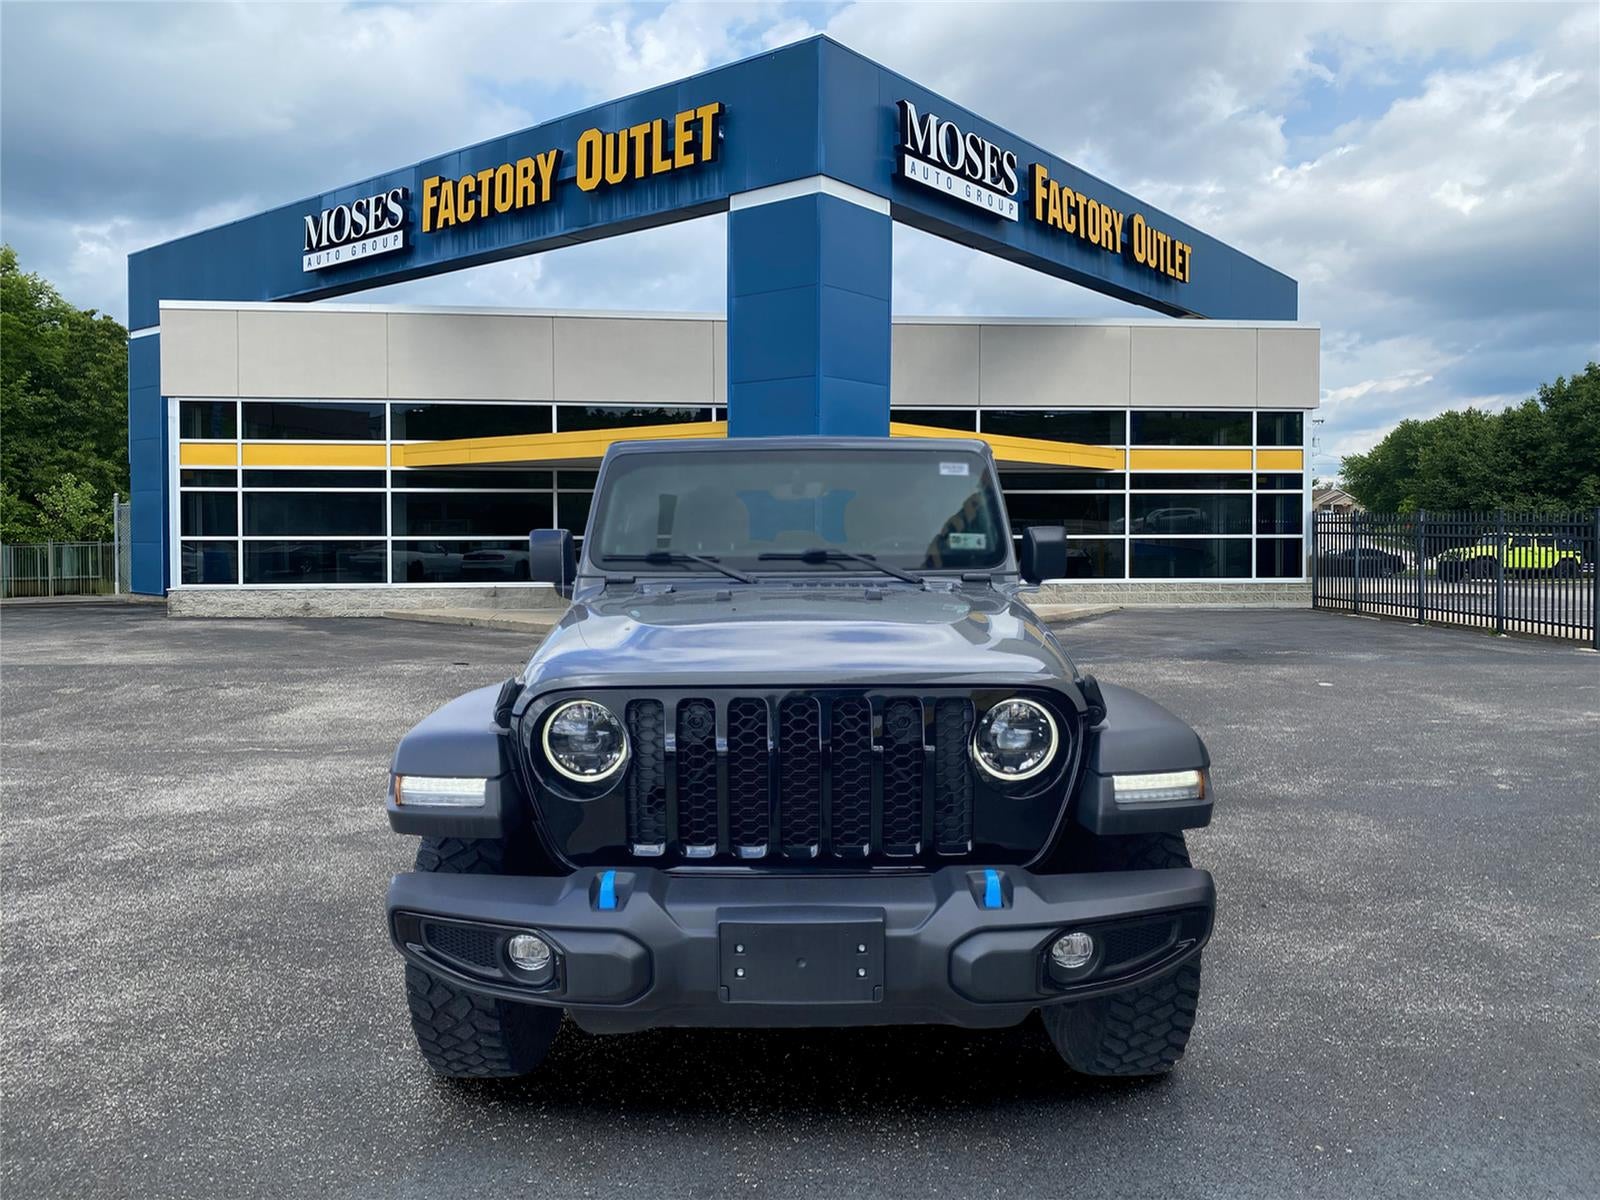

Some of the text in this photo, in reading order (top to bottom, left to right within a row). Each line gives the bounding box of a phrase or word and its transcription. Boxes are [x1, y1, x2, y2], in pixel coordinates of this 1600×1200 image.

[422, 102, 721, 233] FACTORY OUTLET
[904, 100, 1019, 196] MOSES
[910, 161, 1015, 215] AUTO GROUP
[303, 187, 404, 251] MOSES
[307, 234, 400, 267] AUTO GROUP
[1035, 163, 1192, 283] FACTORY OUTLET
